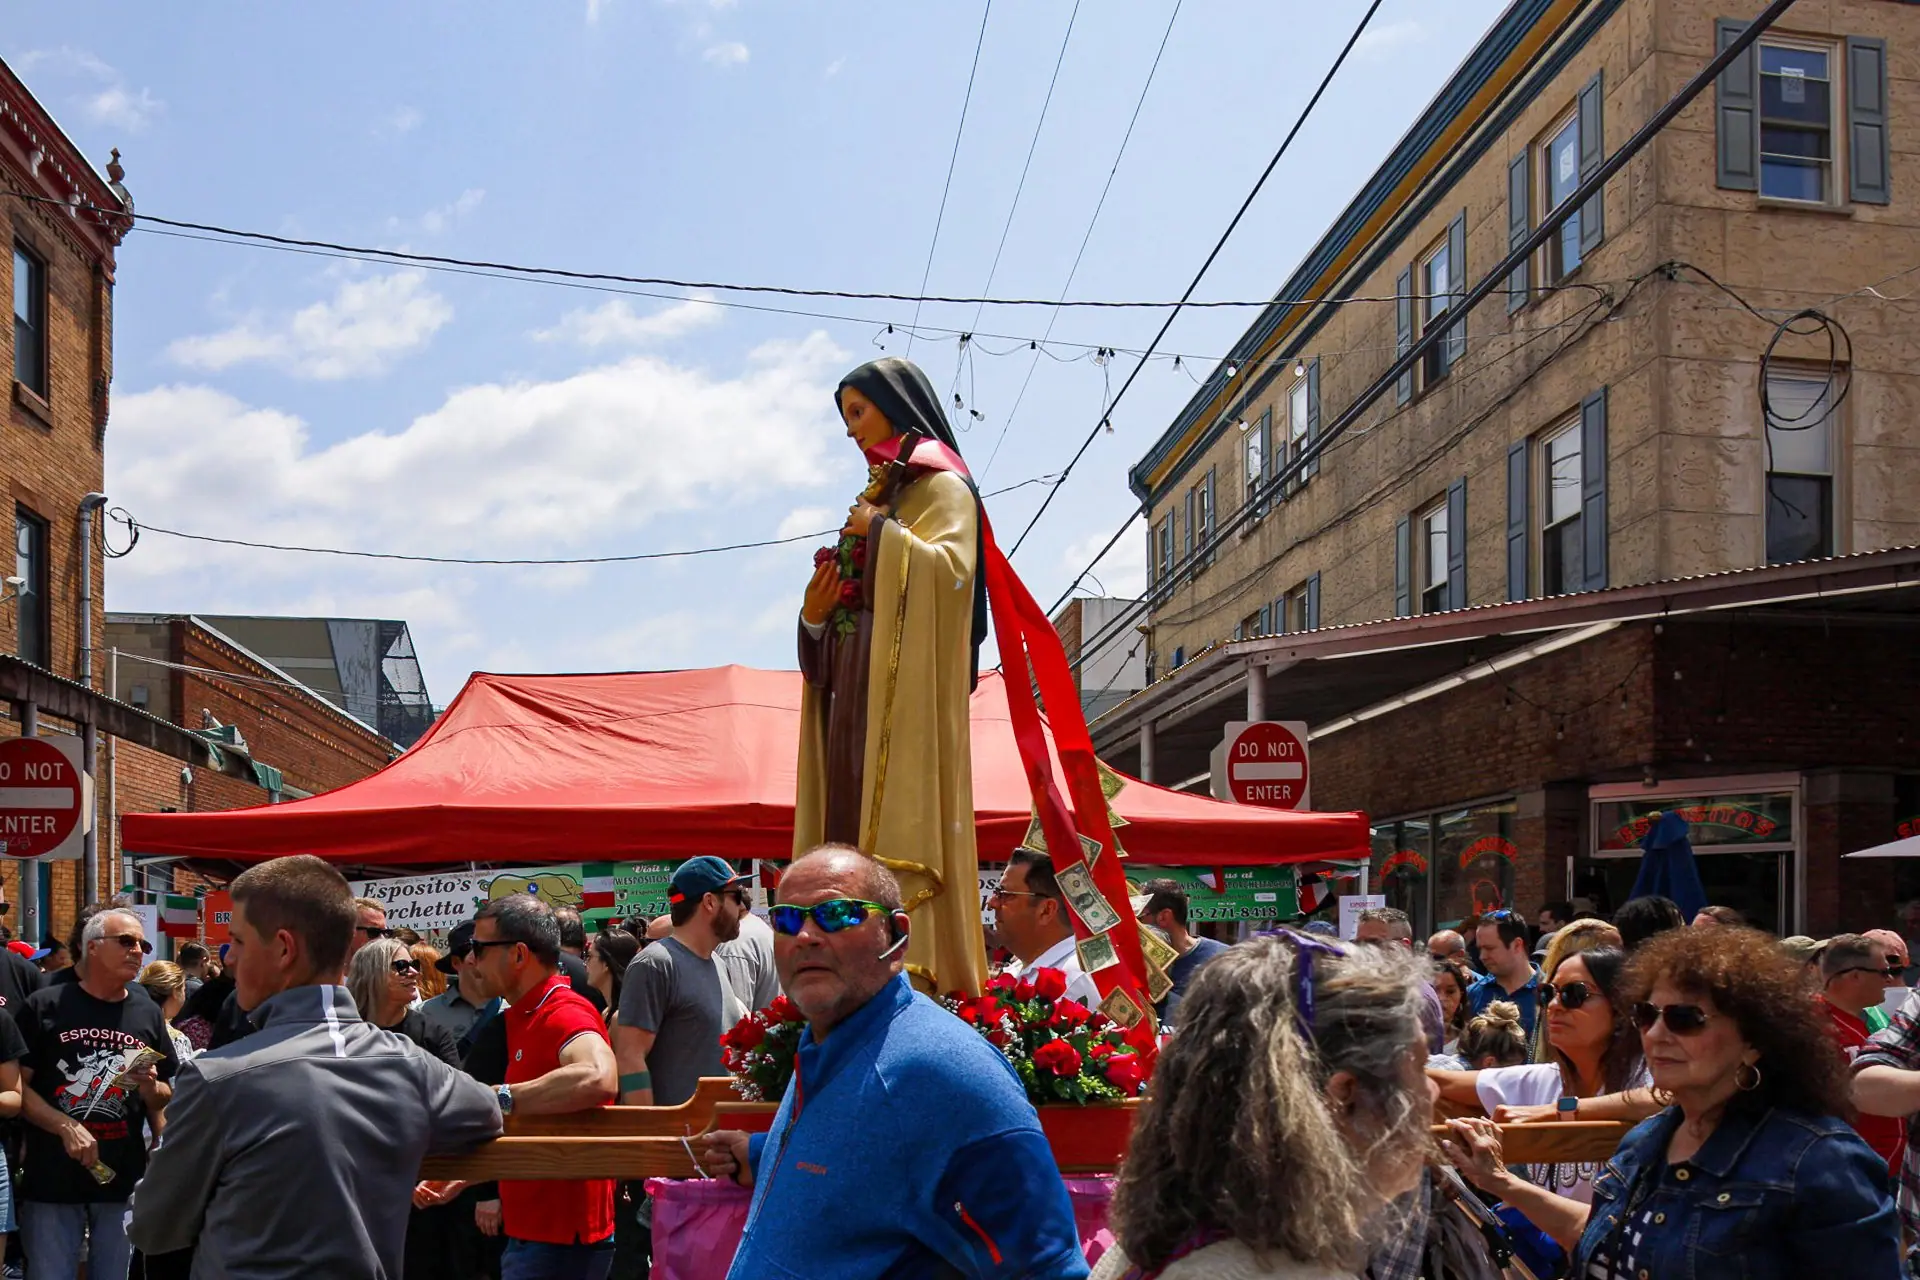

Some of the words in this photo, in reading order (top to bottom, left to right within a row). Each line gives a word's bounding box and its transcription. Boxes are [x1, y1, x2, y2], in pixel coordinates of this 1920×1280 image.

[1239, 742, 1258, 757] DO
[1268, 742, 1295, 757] NOT
[0, 762, 11, 780] O
[24, 762, 64, 780] NOT
[1246, 785, 1291, 800] ENTER
[0, 815, 56, 834] NTER
[362, 877, 472, 904] Esposito's
[383, 900, 465, 920] orchetta
[616, 902, 667, 915] 215-27
[1188, 906, 1278, 919] 15-271-8418
[59, 1027, 146, 1050] ESPOSITO'S
[83, 1039, 123, 1050] MEATS
